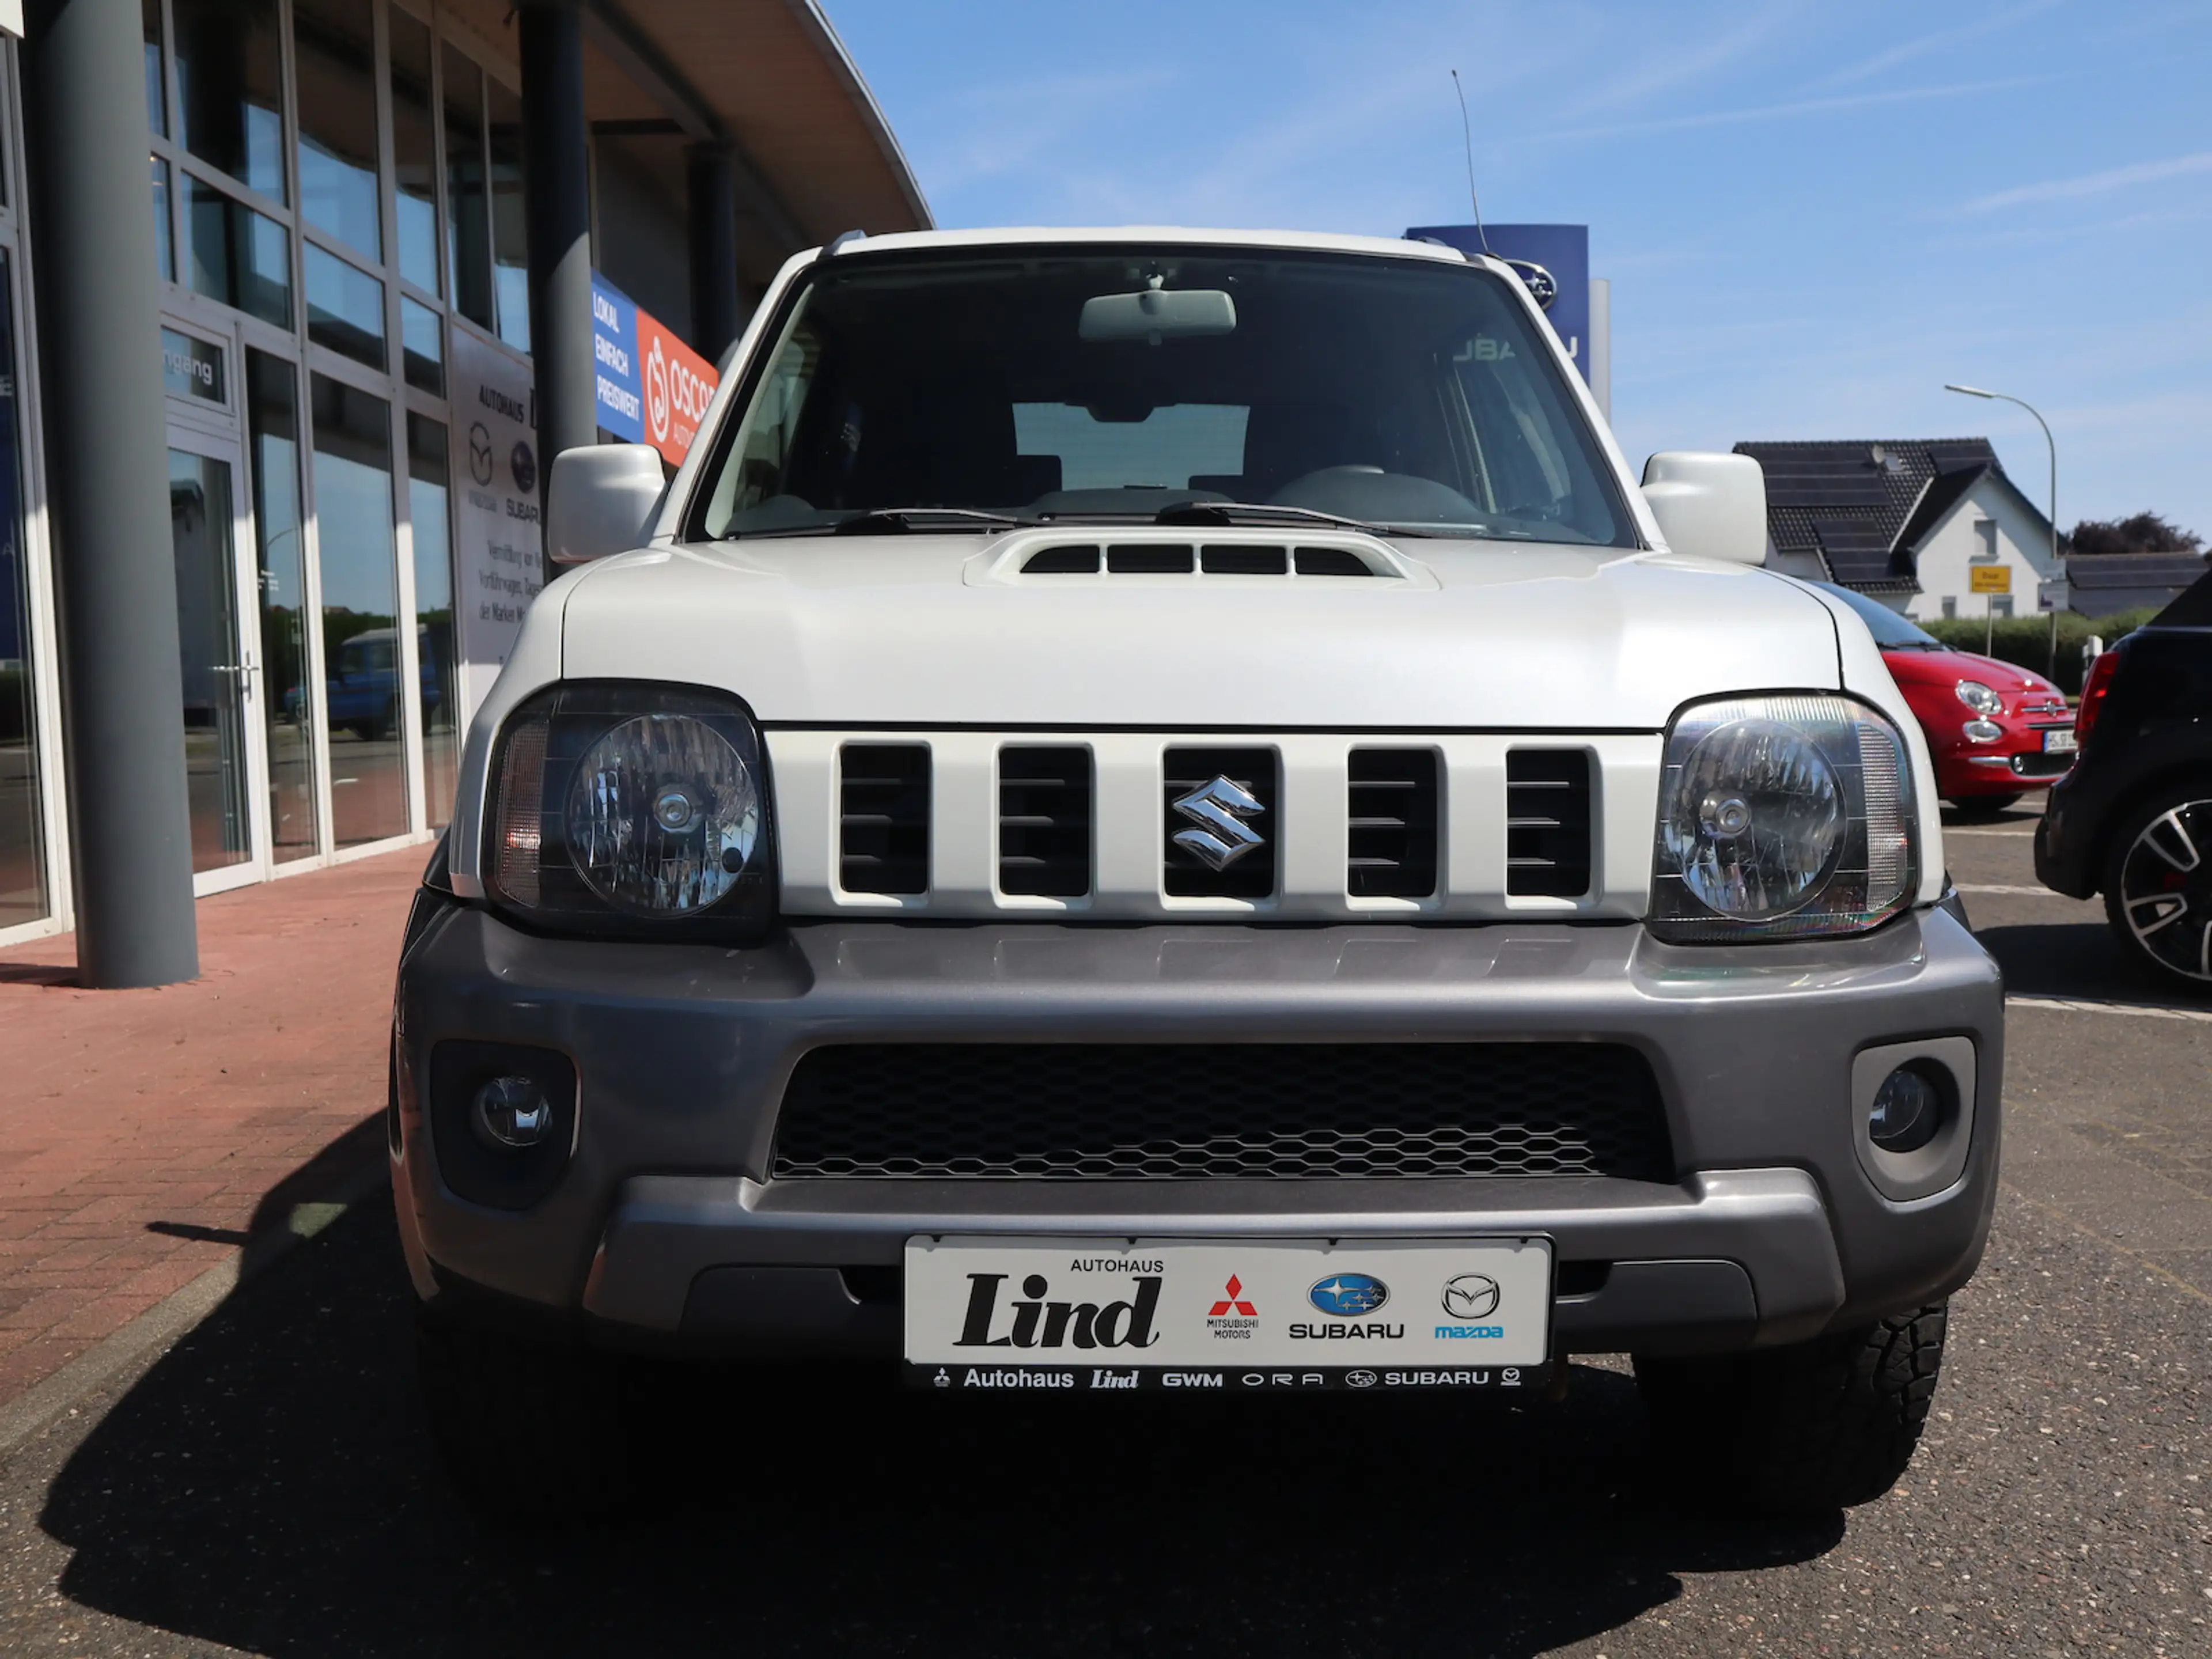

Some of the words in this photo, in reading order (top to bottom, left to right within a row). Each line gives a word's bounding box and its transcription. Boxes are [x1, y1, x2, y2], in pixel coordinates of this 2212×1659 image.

[592, 291, 620, 334] LOKAL
[595, 334, 629, 377] EINFACH
[479, 384, 525, 424] AUTOHAUS
[596, 374, 640, 422] PREISWERT
[506, 498, 540, 524] SUBAR
[1070, 1259, 1164, 1272] AUTOHAUS
[952, 1273, 1162, 1349] Lind
[1207, 1319, 1259, 1328] MITSUBISHI
[1214, 1329, 1251, 1339] MOTORS
[1289, 1324, 1404, 1339] SUBARU
[963, 1368, 1074, 1388] Autohaus
[1089, 1369, 1140, 1389] Lind
[1162, 1373, 1223, 1387] GWM
[1241, 1372, 1323, 1385] ORA
[1385, 1372, 1488, 1385] SUBARU
